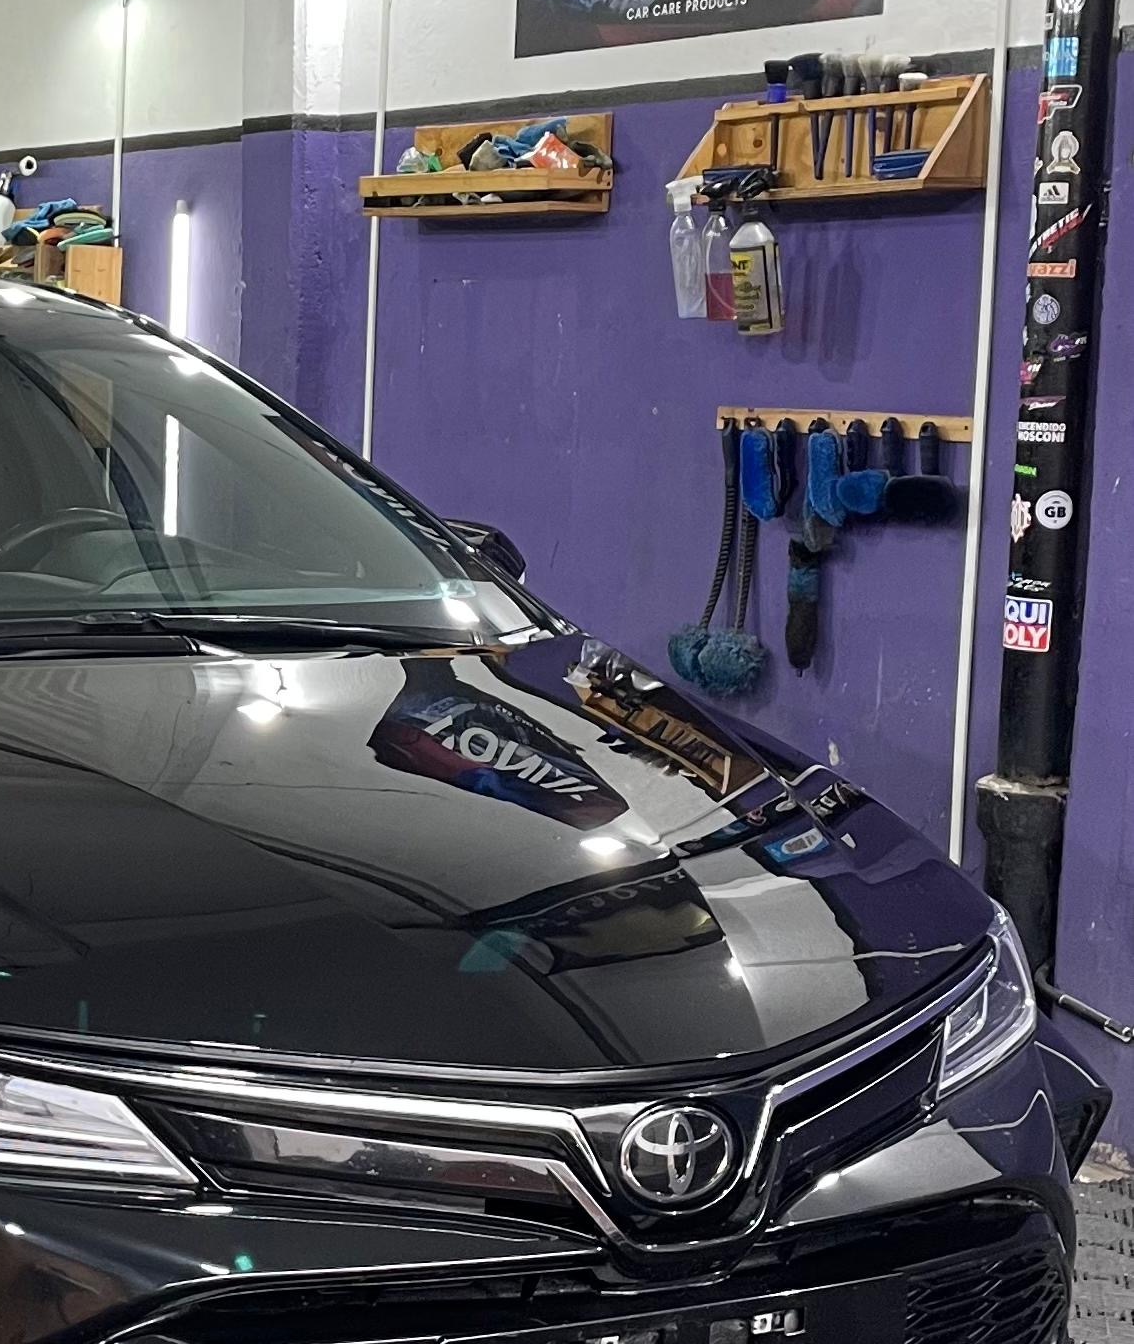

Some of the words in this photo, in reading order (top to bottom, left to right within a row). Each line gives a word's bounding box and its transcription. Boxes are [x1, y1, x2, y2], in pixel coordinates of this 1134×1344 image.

[626, 7, 649, 21] CAR
[652, 0, 682, 17] CARE
[1044, 506, 1067, 518] GB
[1004, 600, 1047, 625] QUI
[1004, 623, 1047, 648] OLY
